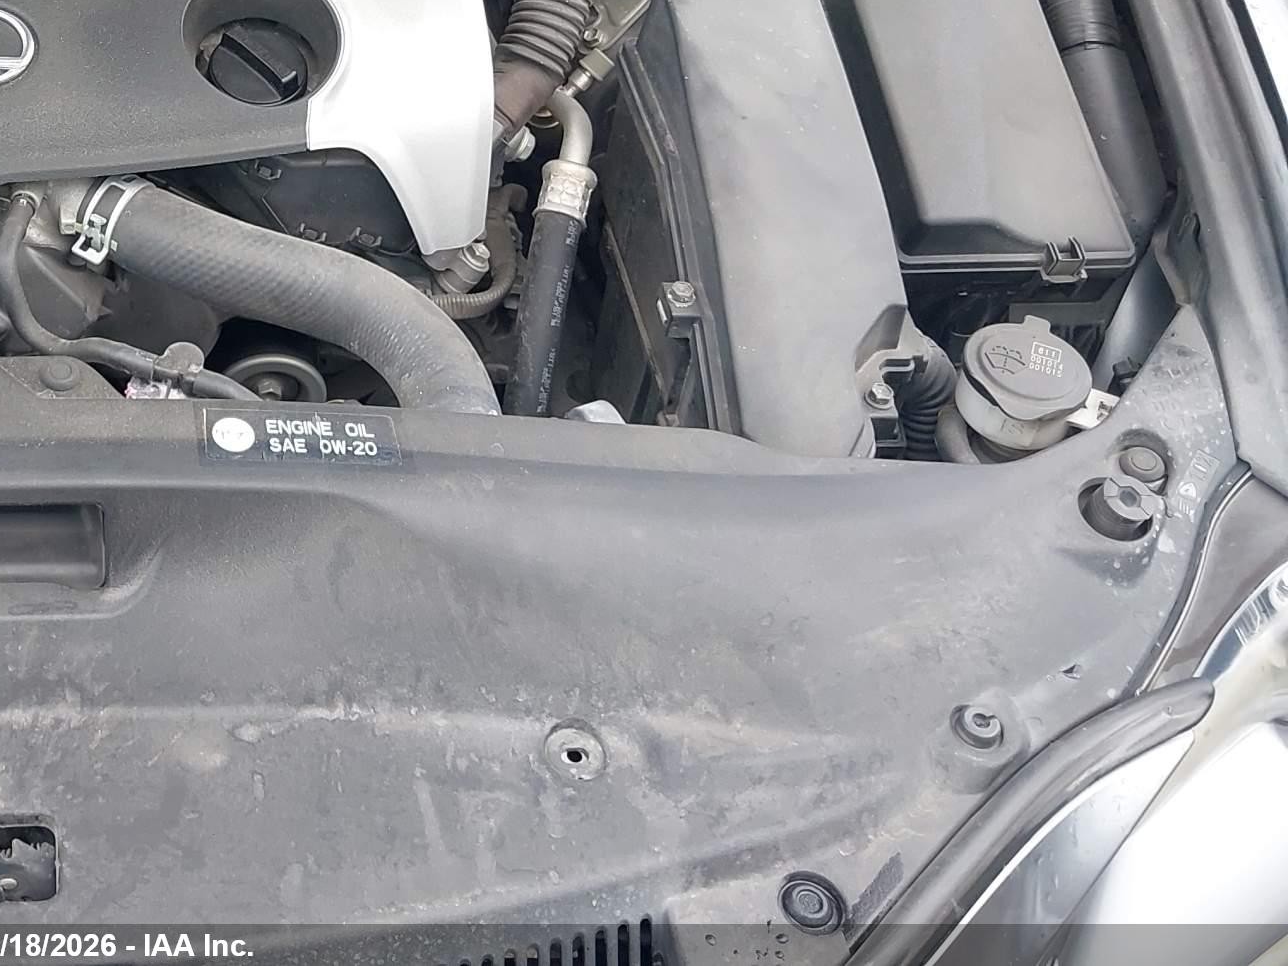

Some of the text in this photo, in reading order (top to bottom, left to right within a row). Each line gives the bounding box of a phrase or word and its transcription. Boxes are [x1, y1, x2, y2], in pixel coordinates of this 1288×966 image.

[265, 419, 376, 438] ENGINE OIL
[269, 437, 378, 456] SAE 0W-20
